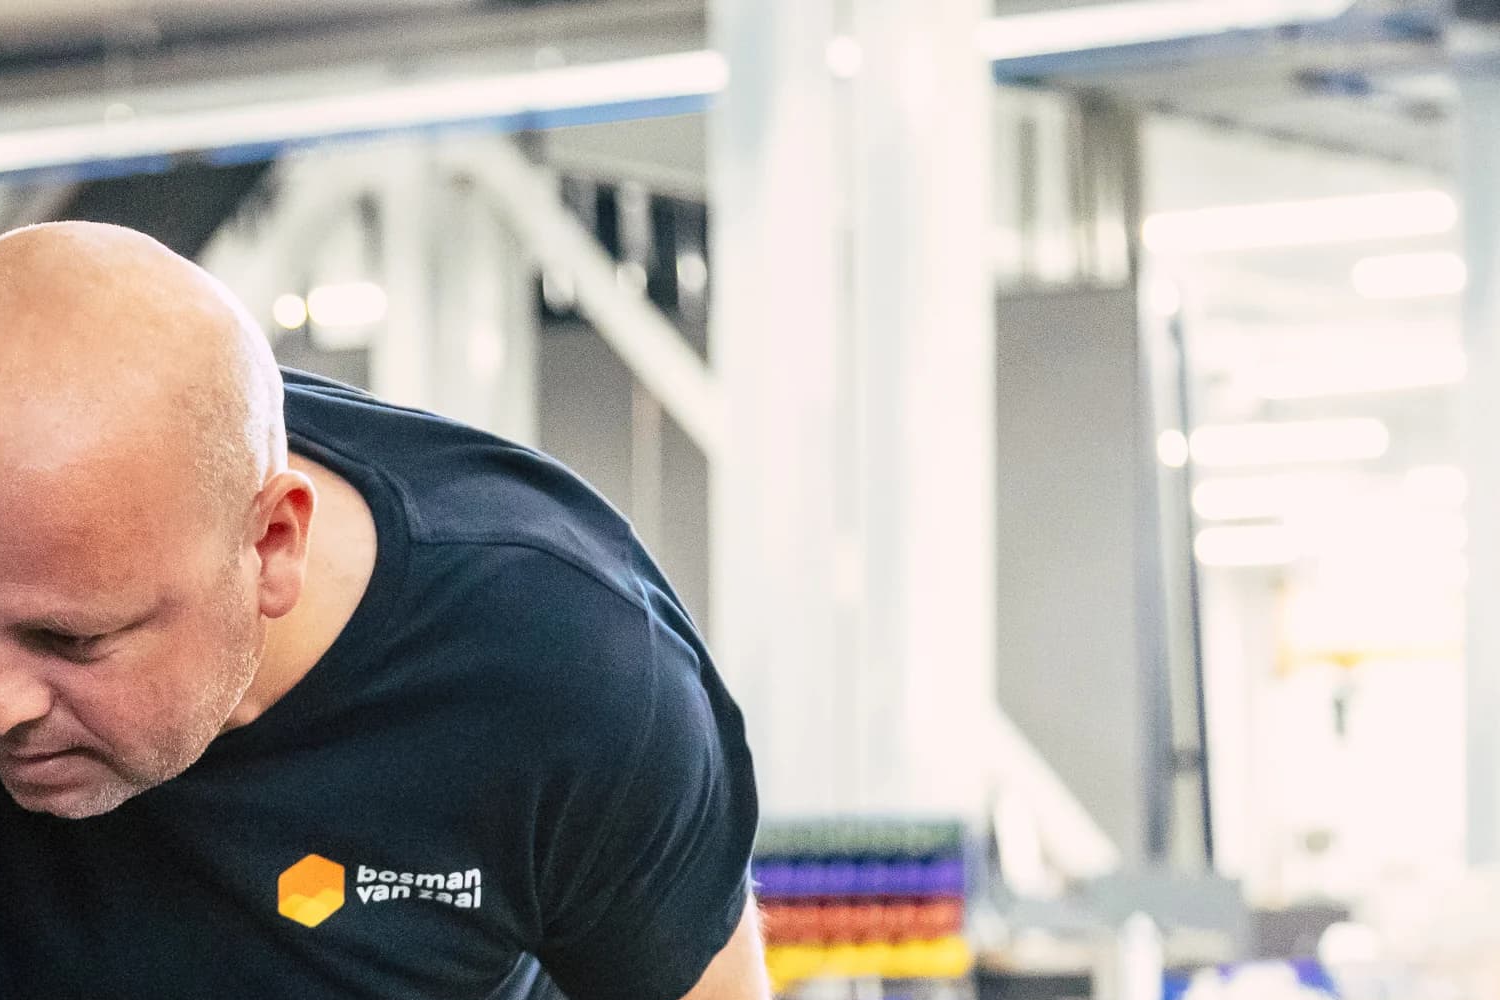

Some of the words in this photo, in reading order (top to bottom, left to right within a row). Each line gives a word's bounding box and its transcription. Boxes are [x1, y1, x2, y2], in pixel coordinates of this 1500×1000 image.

[356, 865, 482, 890] bosman
[356, 883, 411, 905] van
[418, 886, 482, 909] zaal
